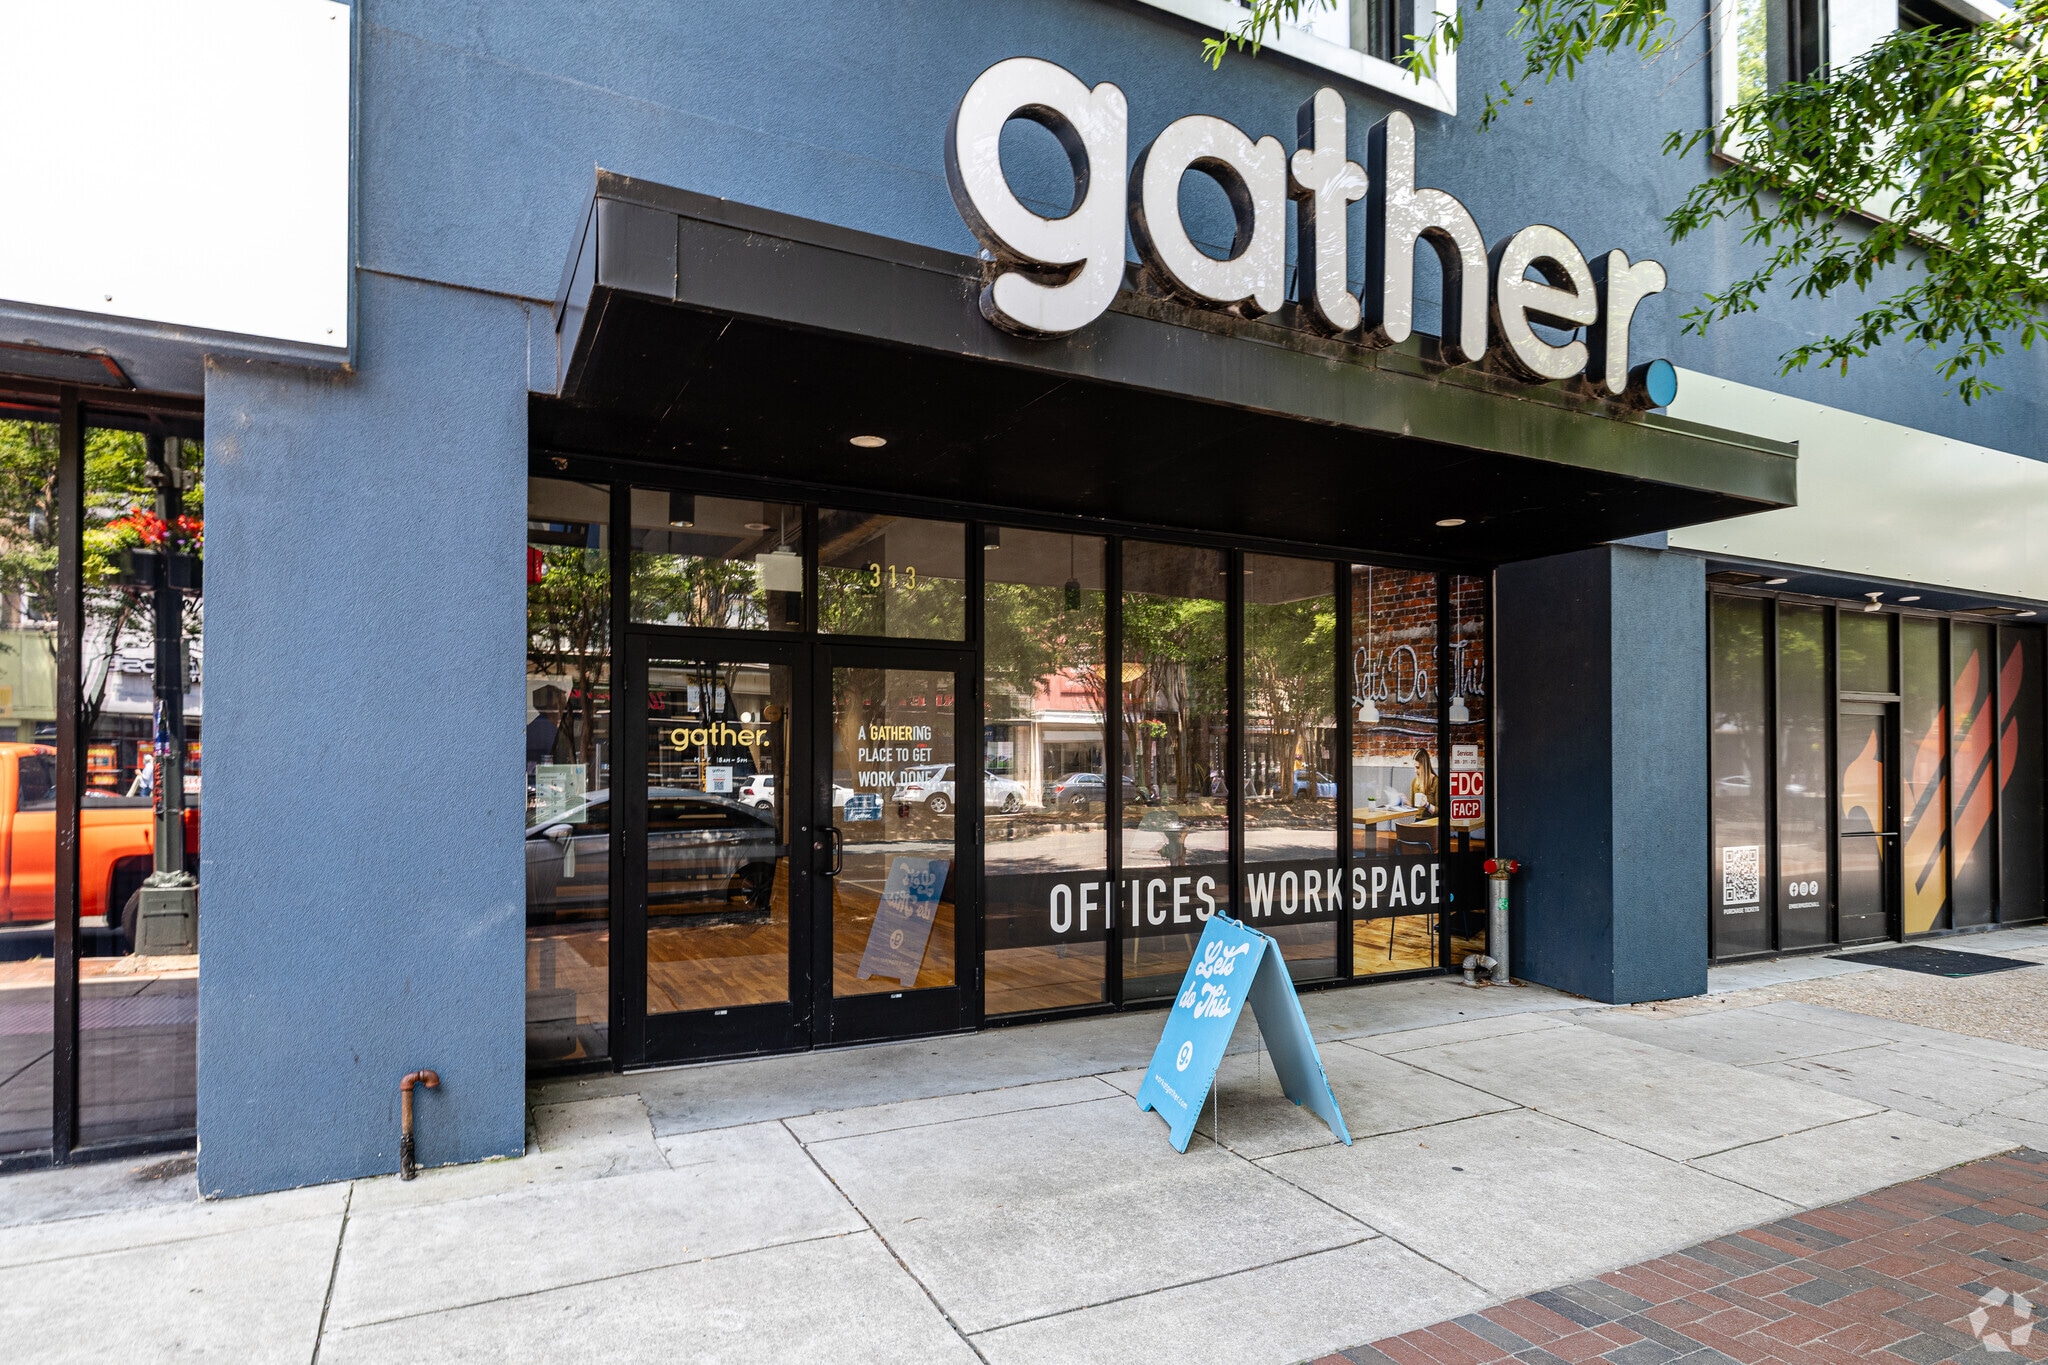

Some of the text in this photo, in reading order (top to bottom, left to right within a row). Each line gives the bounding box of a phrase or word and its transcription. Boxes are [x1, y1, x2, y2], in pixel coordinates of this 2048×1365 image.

[946, 56, 1677, 409] gather.
[869, 562, 916, 590] 313
[1388, 643, 1428, 704] Do
[671, 722, 770, 752] gather.
[858, 725, 932, 741] A GATHERING
[858, 747, 932, 762] PLACE TO GET
[858, 770, 896, 787] WORK
[1449, 772, 1483, 796] FDC
[1453, 802, 1479, 816] FACP
